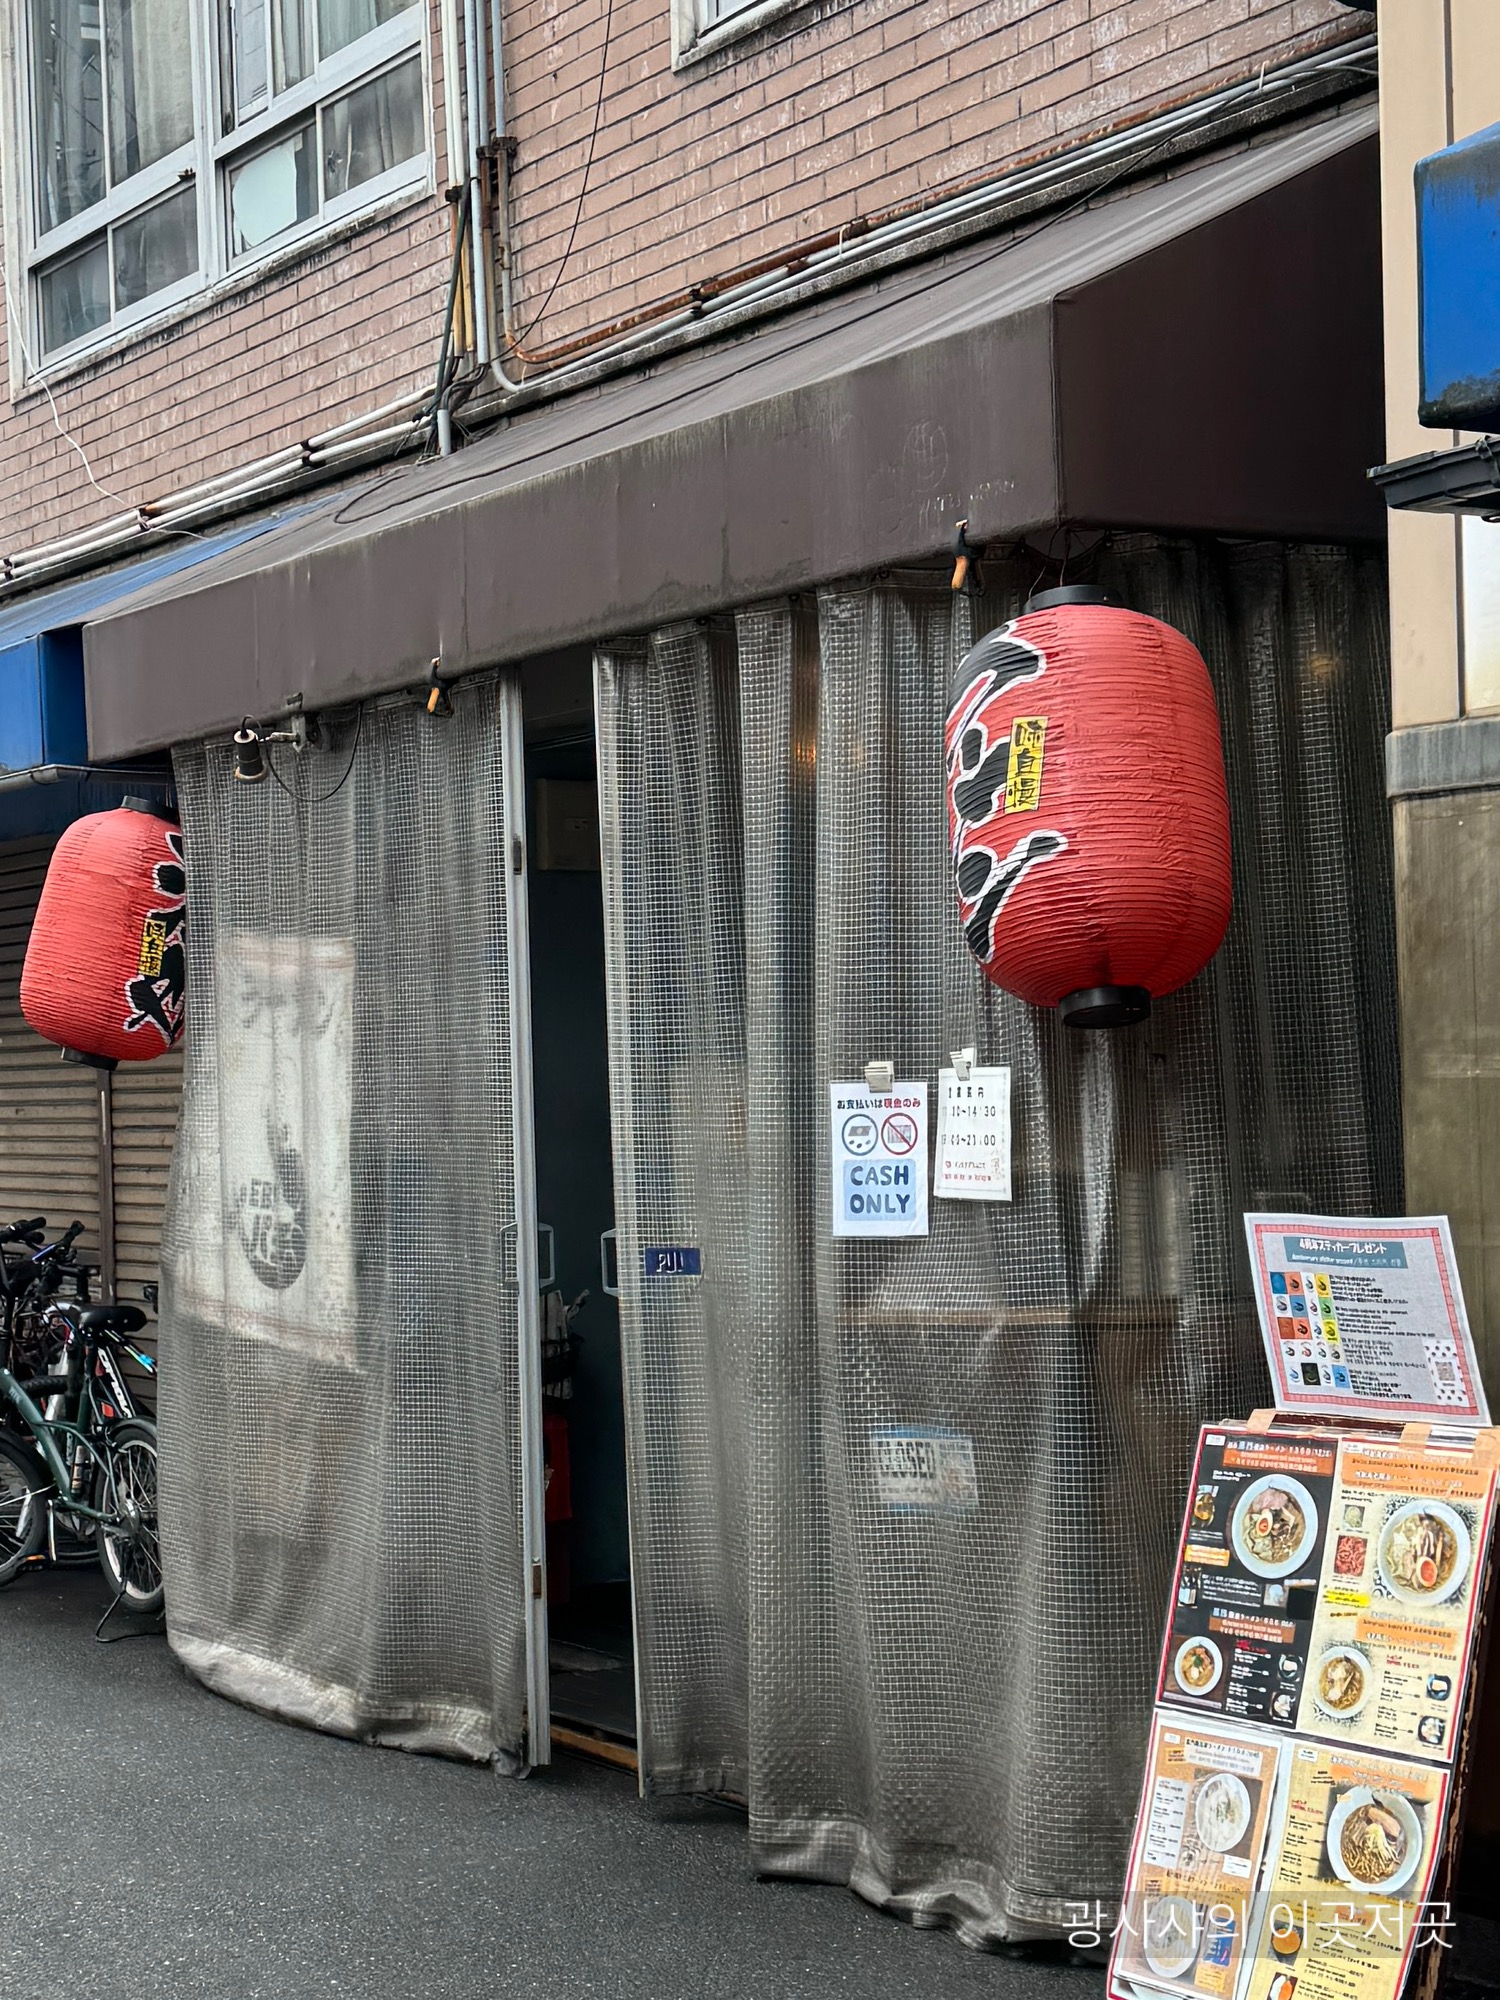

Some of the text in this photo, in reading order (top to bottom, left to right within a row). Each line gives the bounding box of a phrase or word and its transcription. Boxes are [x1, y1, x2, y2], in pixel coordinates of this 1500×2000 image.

[1008, 720, 1045, 809] 味自慢
[837, 1098, 921, 1110] お支払いは現金のみ
[850, 1165, 909, 1186] CASH
[849, 1193, 910, 1214] ONLY
